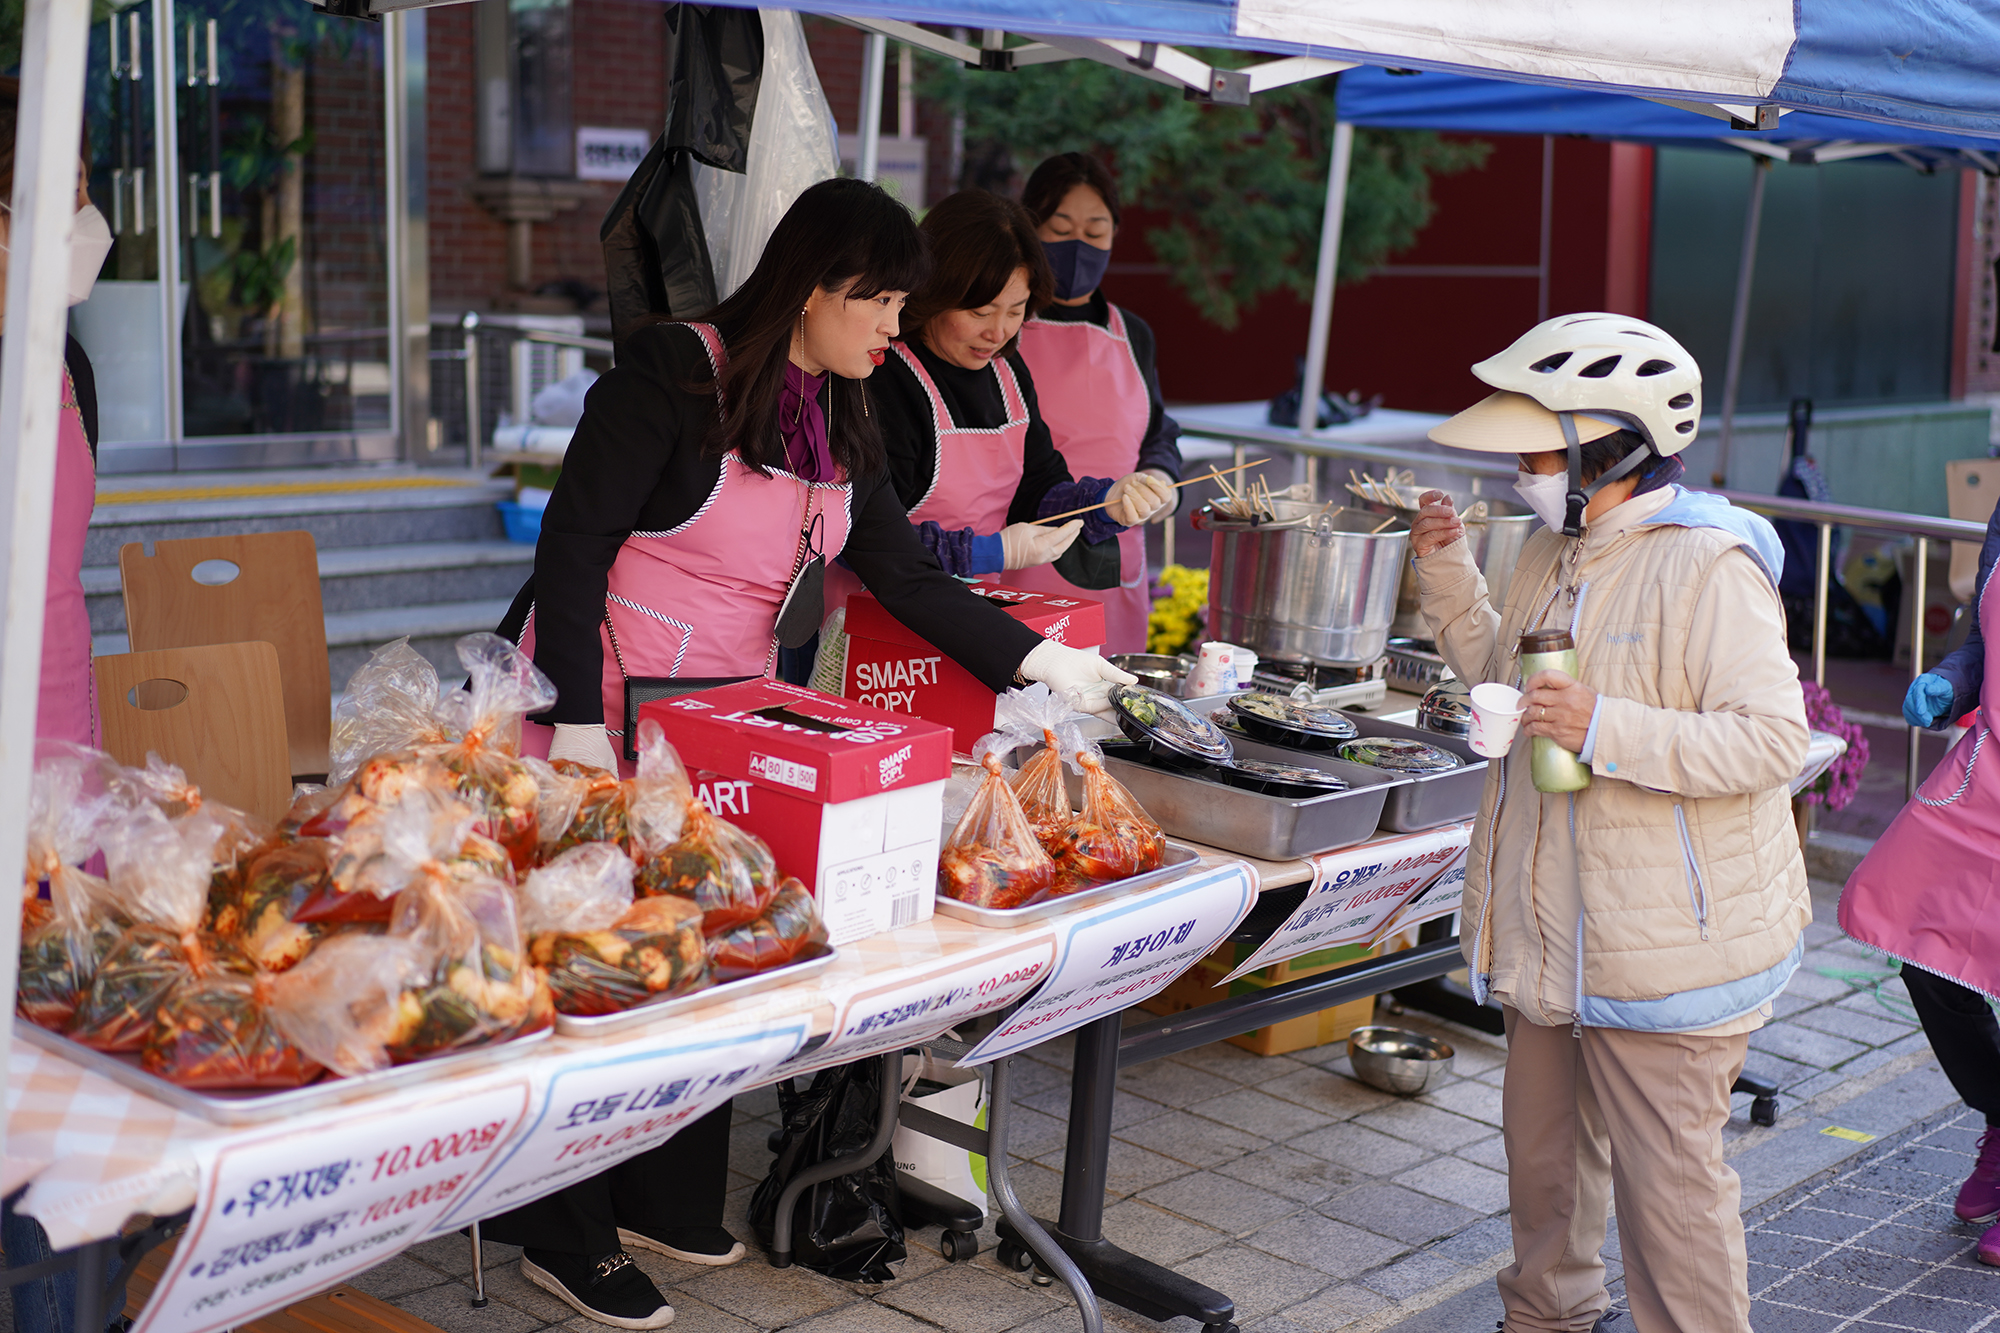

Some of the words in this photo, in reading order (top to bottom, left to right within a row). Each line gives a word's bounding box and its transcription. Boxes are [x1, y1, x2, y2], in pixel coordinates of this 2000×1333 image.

[972, 587, 1044, 601] ART
[1044, 615, 1071, 638] SMART
[1047, 630, 1065, 642] OPY
[830, 648, 844, 661] AKE
[856, 656, 941, 690] SMART
[858, 690, 916, 713] COPY
[833, 715, 862, 726] Copy
[750, 756, 766, 771] A4
[767, 761, 781, 775] 80
[788, 766, 795, 779] 5
[800, 770, 815, 785] 500
[879, 745, 912, 773] SMART
[879, 763, 904, 785] COPY
[690, 780, 754, 816] ART
[1344, 877, 1421, 912] 10,000원
[1100, 918, 1197, 969] 계좌이체
[998, 968, 1178, 1038] 458301-01-540701
[555, 1092, 629, 1131] 모듬
[555, 1101, 704, 1162] 10,000원
[370, 1118, 507, 1182] 10,000원
[895, 1161, 916, 1171] UNG
[360, 1171, 469, 1227] 10,000원
